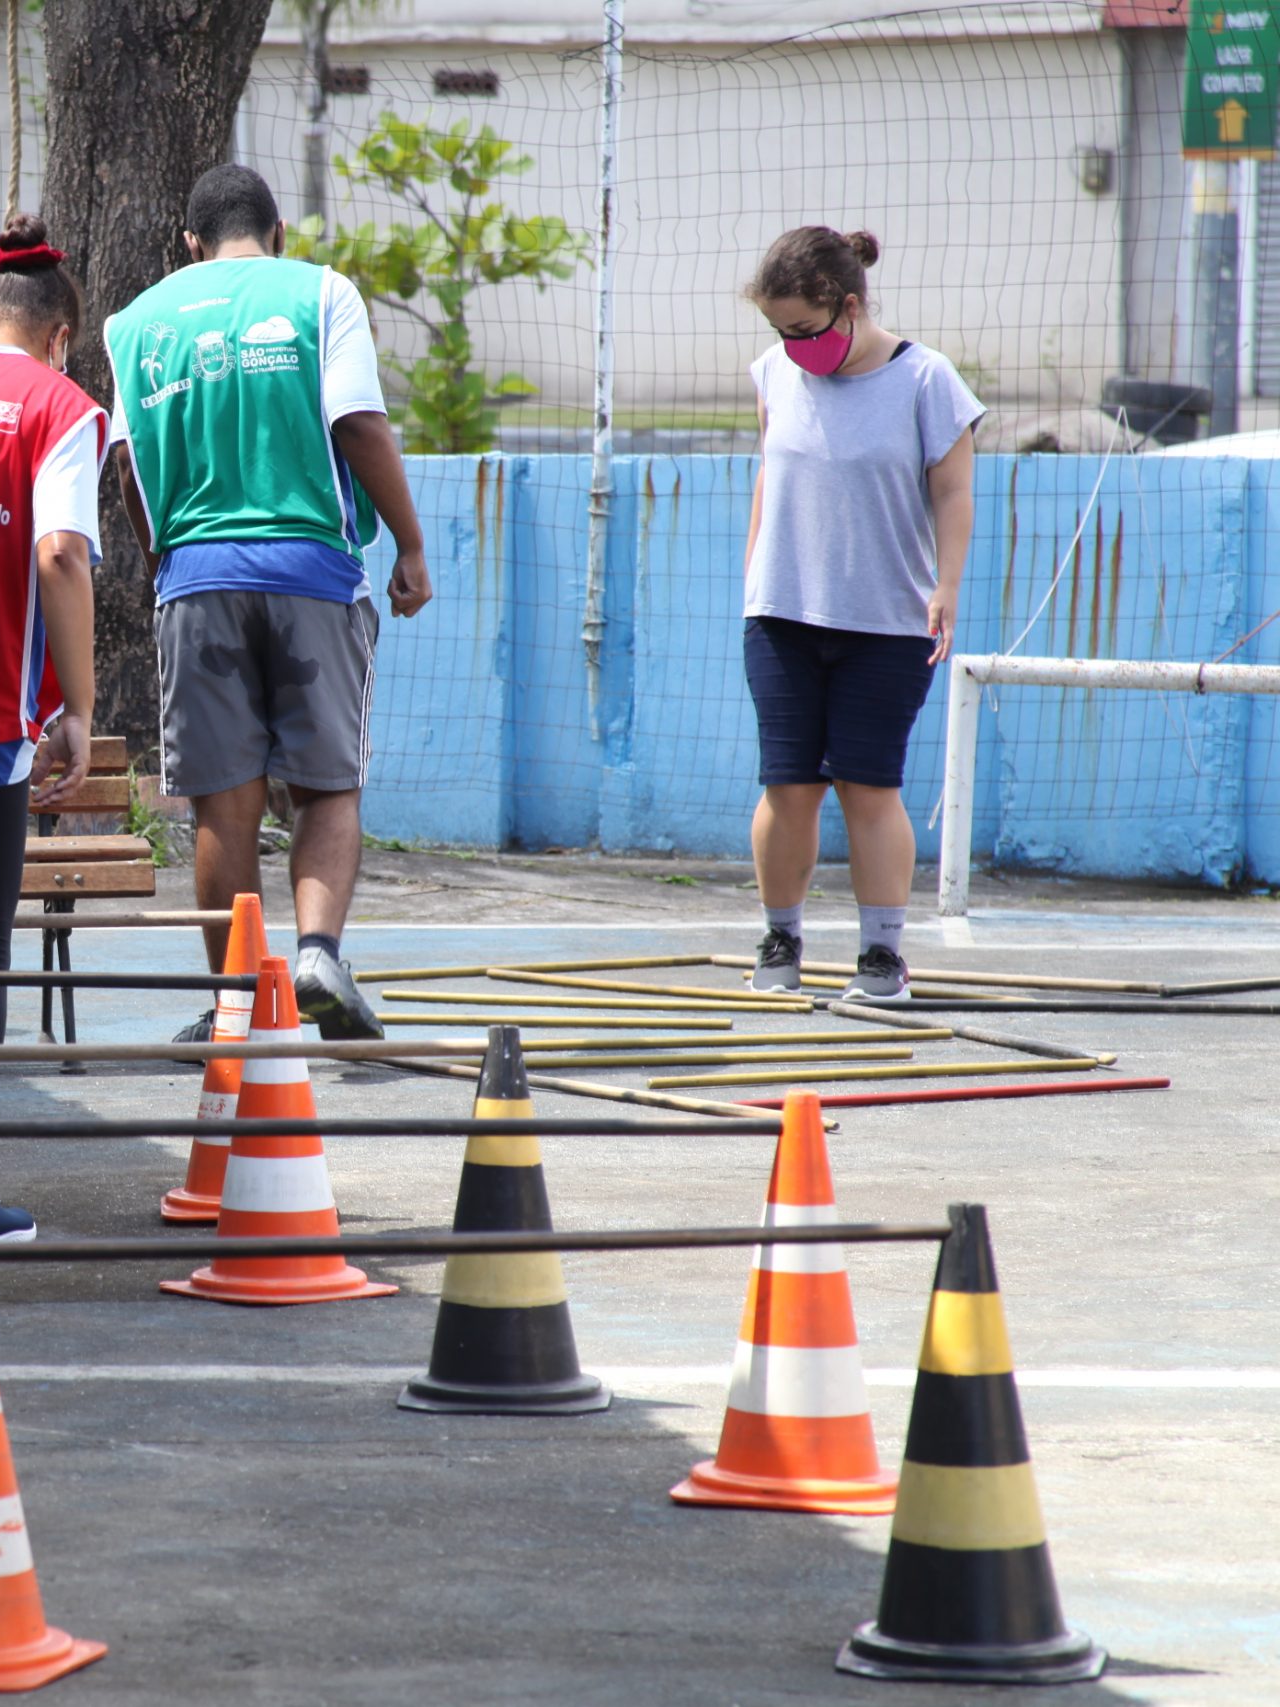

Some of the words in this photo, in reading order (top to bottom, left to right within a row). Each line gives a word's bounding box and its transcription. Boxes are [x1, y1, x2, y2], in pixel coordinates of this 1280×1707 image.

[1216, 45, 1253, 65] LAZER
[1202, 72, 1265, 93] COMPLETO
[240, 347, 265, 358] SÃO
[241, 354, 298, 368] GONÇALO
